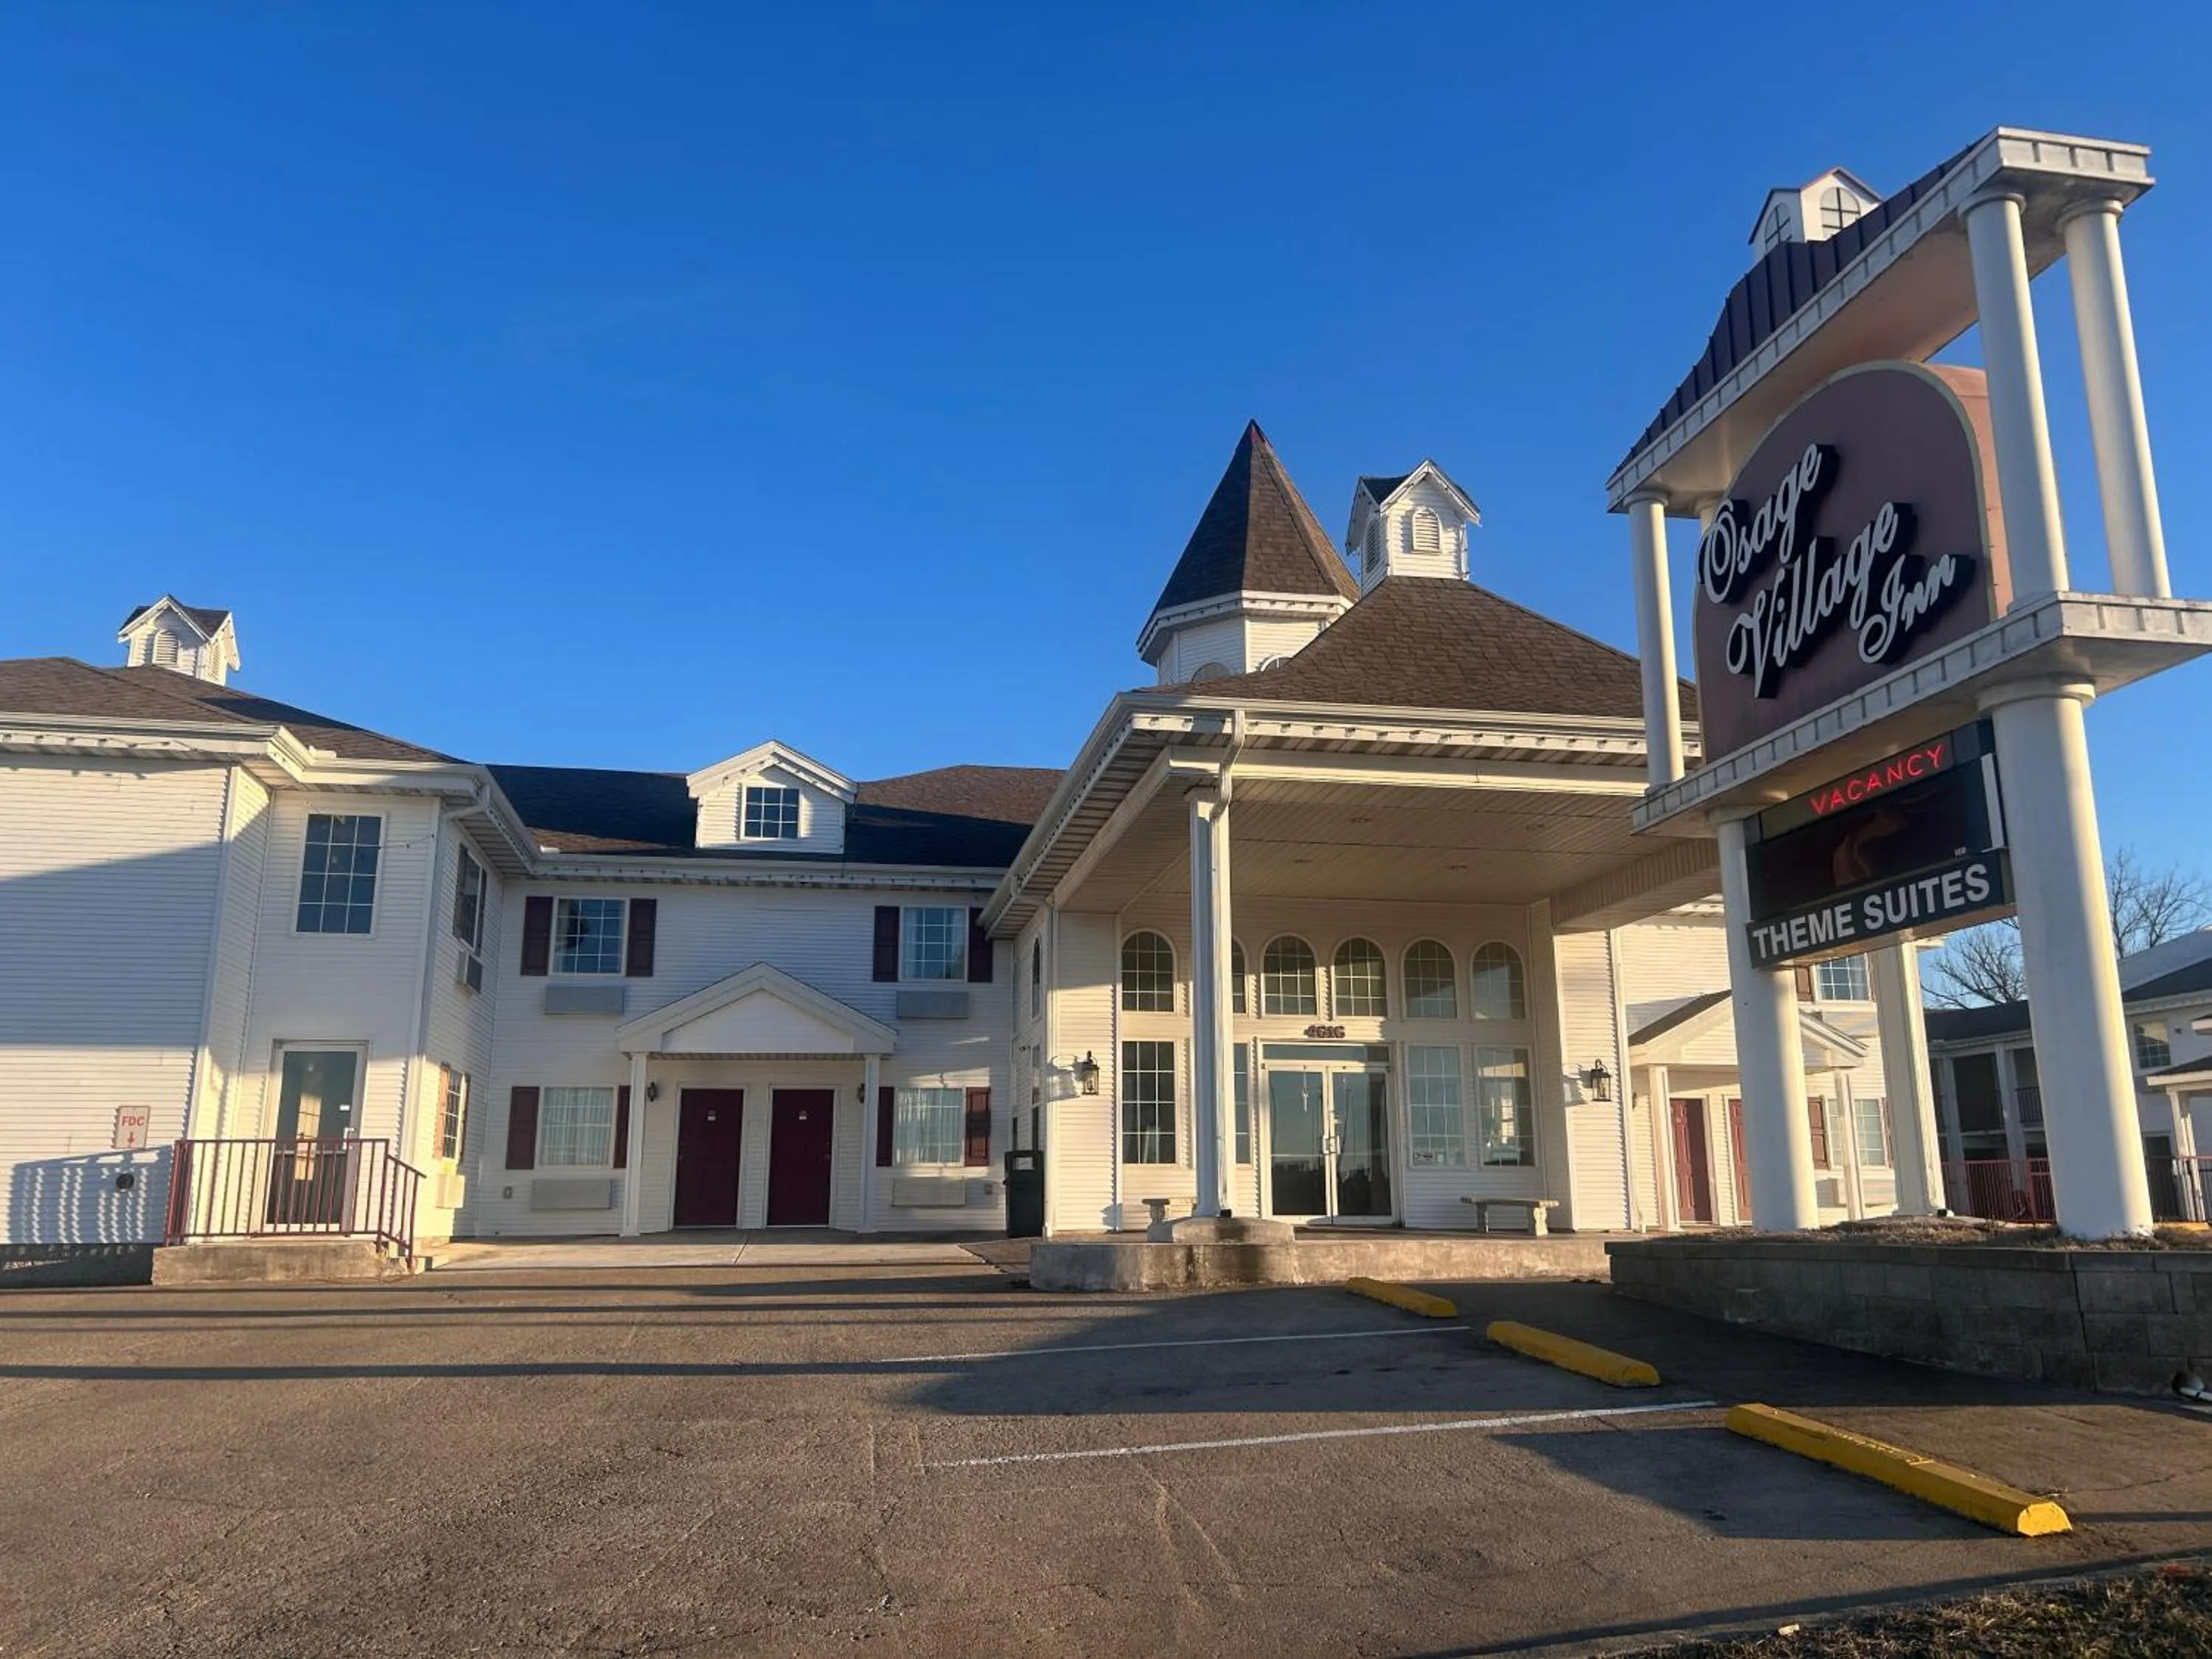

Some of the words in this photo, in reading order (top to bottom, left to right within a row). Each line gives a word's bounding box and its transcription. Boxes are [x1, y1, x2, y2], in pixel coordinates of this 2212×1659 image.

[1703, 442, 1823, 604] Osage
[1726, 501, 1899, 699] Village
[1857, 553, 1957, 664] Inn
[1809, 742, 1945, 815] VACANCY
[1752, 902, 1856, 959] THEME
[1863, 863, 1991, 931] SUITES
[122, 1116, 145, 1127] FDC
